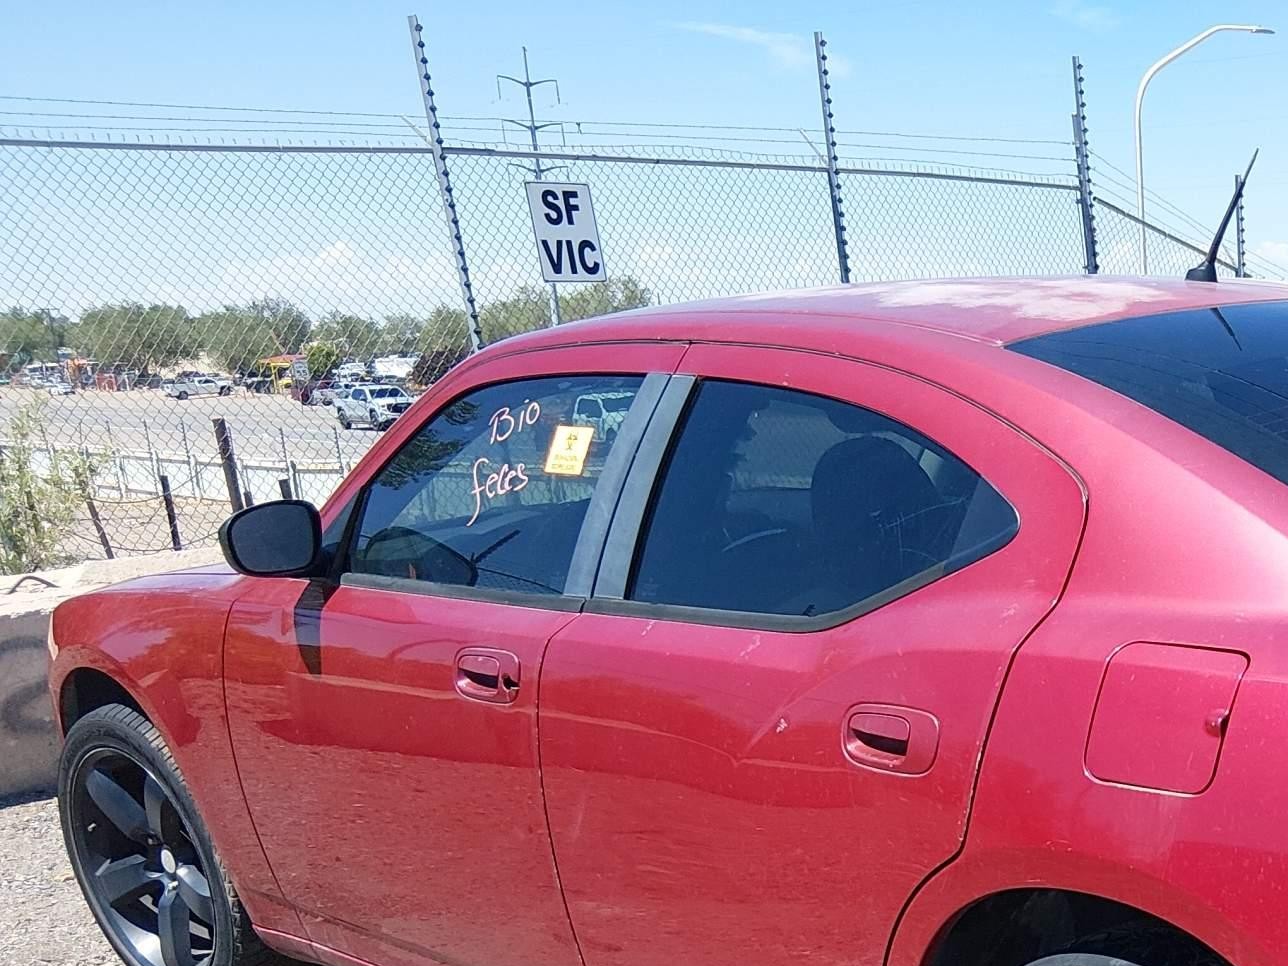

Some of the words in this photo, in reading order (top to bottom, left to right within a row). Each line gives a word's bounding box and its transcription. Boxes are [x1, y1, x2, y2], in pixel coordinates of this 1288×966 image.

[541, 189, 580, 226] SF
[540, 239, 601, 276] VIC
[488, 399, 541, 445] Bio
